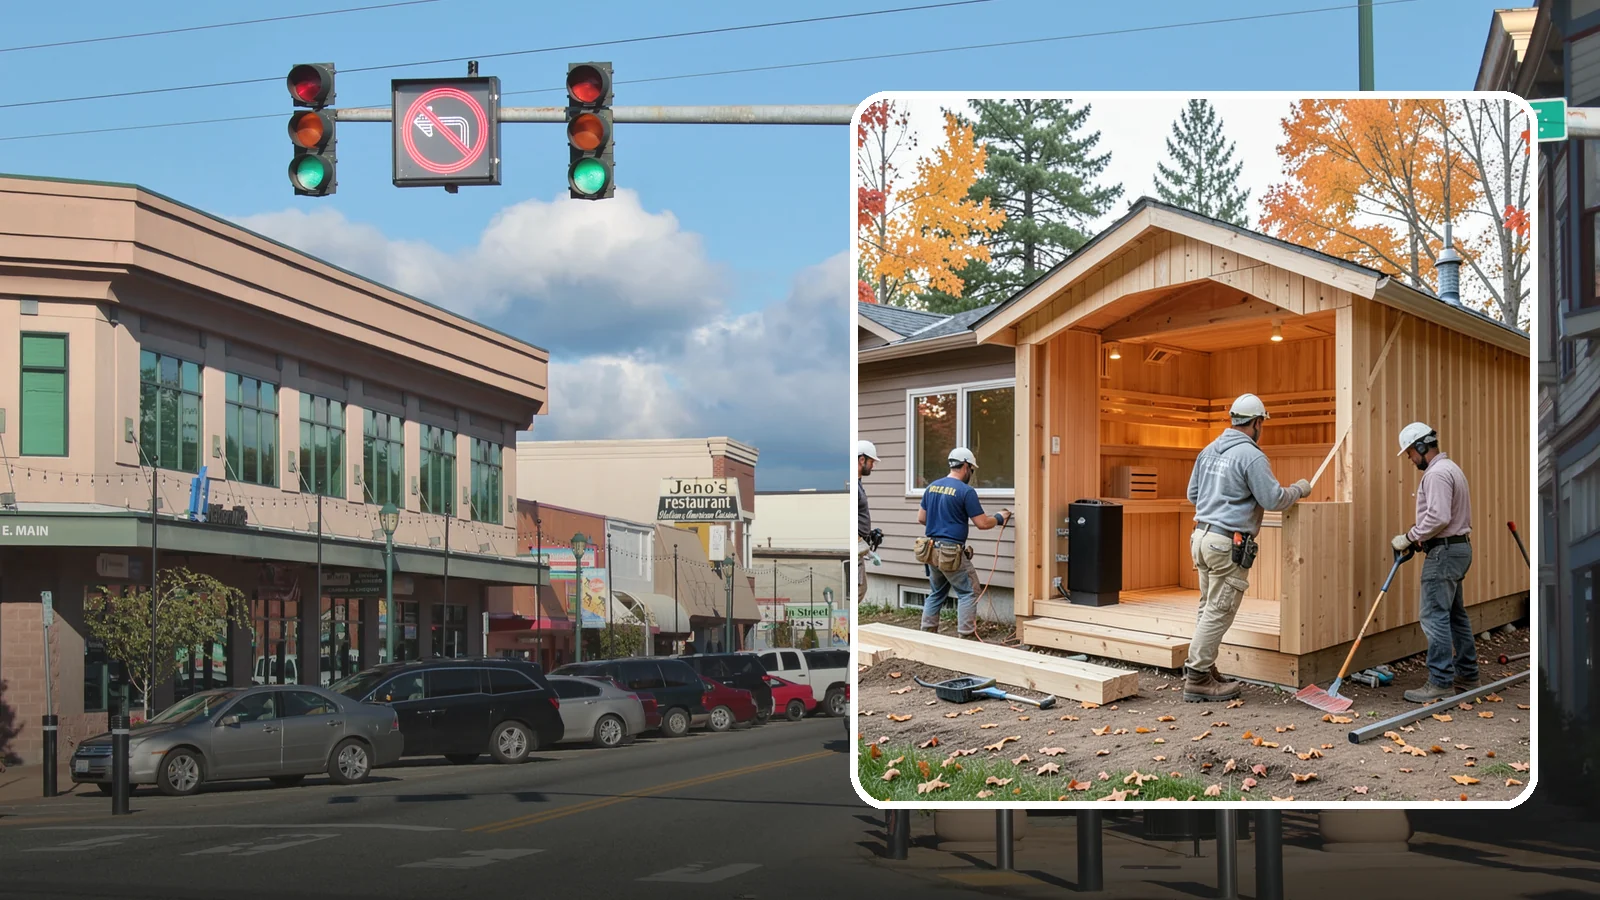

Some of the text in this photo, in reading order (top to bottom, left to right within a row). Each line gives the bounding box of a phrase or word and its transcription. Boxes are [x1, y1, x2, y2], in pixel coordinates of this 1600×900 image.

[670, 480, 728, 495] Jeno's
[665, 496, 731, 509] restaurant
[658, 510, 682, 519] Italian
[685, 509, 714, 519] American
[714, 509, 738, 519] Cuisine
[2, 525, 49, 536] E. MAIN
[797, 607, 828, 616] Street
